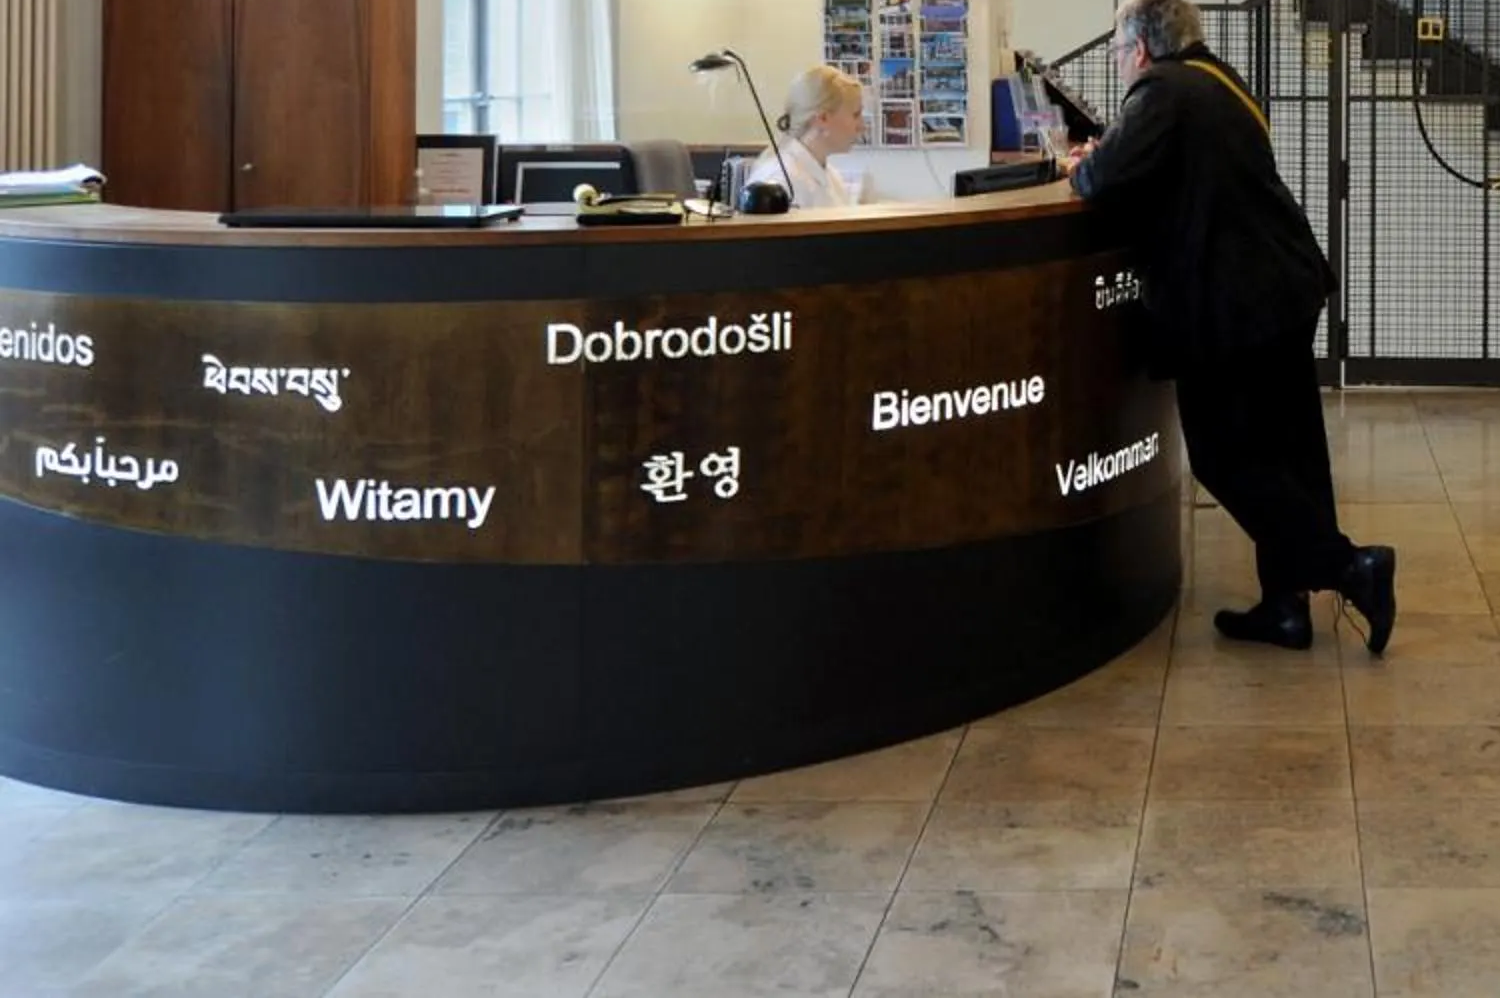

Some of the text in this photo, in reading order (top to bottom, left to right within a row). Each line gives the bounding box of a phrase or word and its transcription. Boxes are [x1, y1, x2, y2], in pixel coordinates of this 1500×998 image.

[0, 321, 95, 367] enidos
[547, 311, 792, 365] Dobrodošli
[872, 375, 1045, 431] Bienvenue
[640, 446, 740, 503] 환영
[1055, 432, 1159, 496] Velkommen
[315, 478, 496, 529] Witamy
